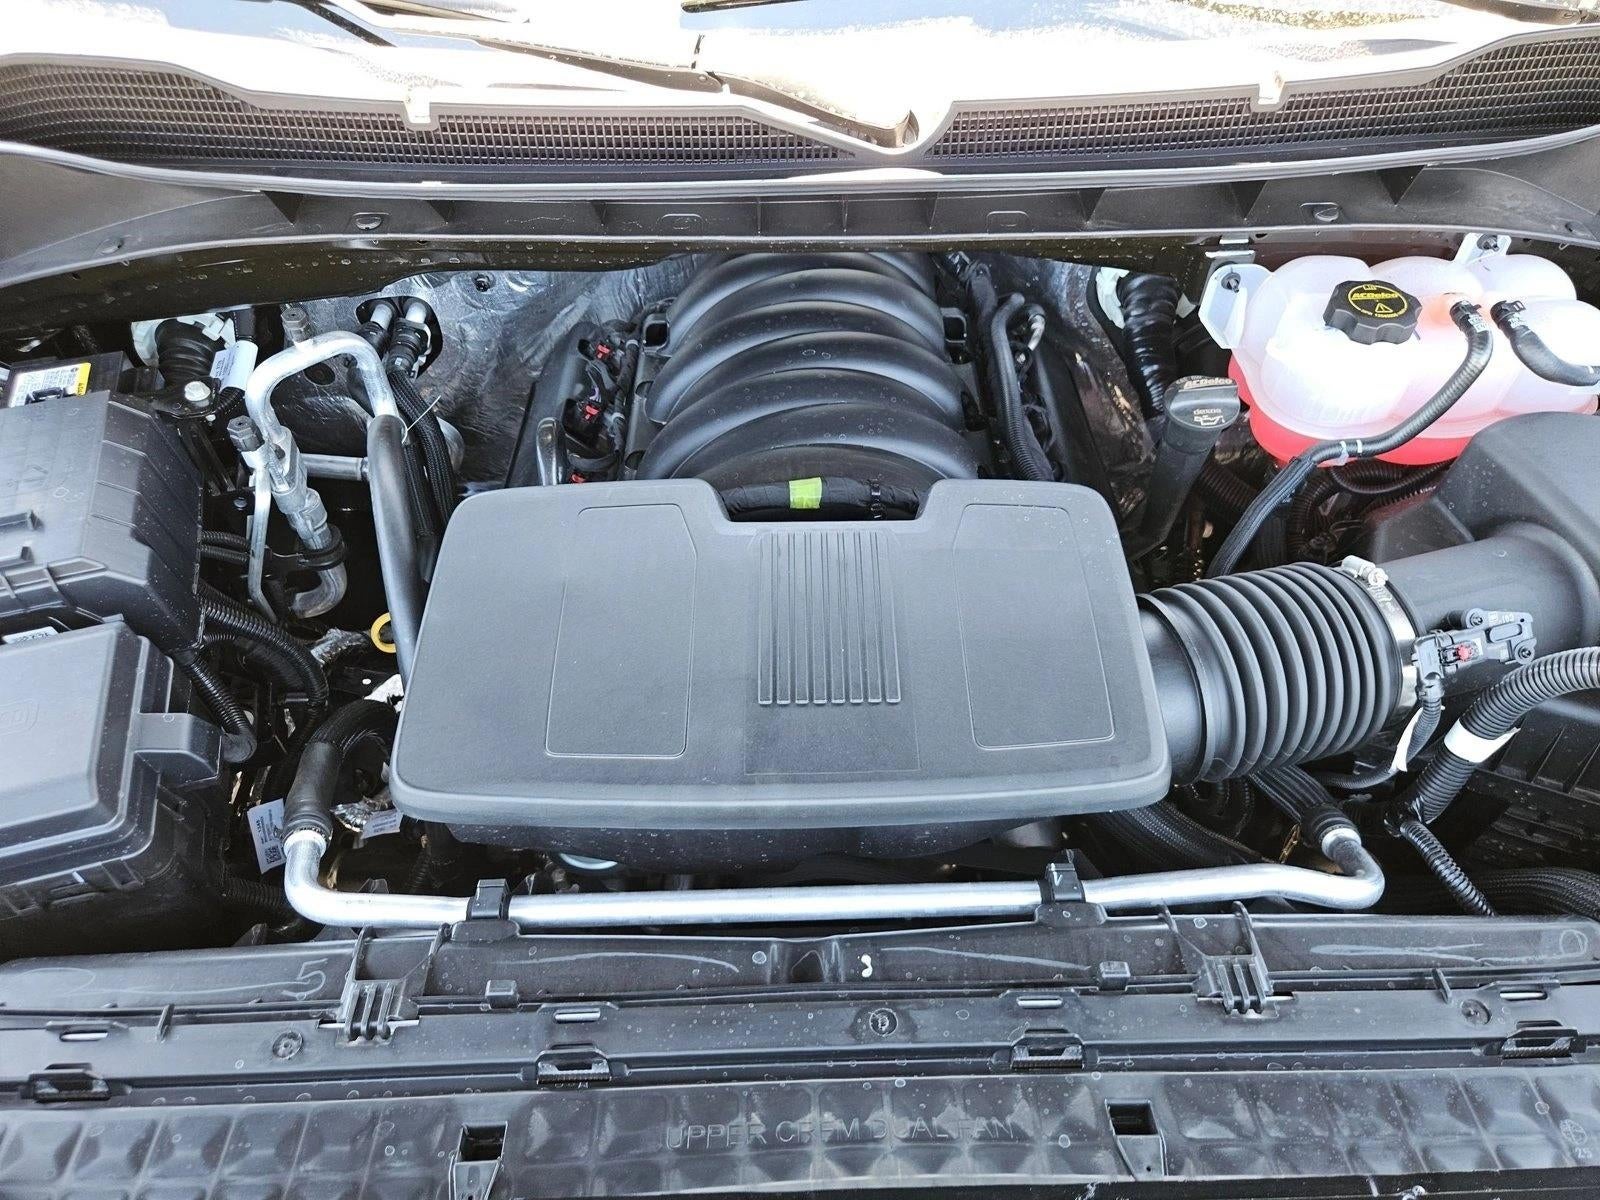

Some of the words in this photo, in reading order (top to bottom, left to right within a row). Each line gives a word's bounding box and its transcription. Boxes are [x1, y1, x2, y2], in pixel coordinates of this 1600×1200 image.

[1351, 292, 1398, 301] ACDelco
[1183, 377, 1233, 390] ACDelco
[666, 1119, 767, 1150] UPPER
[868, 1116, 949, 1140] DUAL
[958, 1115, 1014, 1140] FAN
